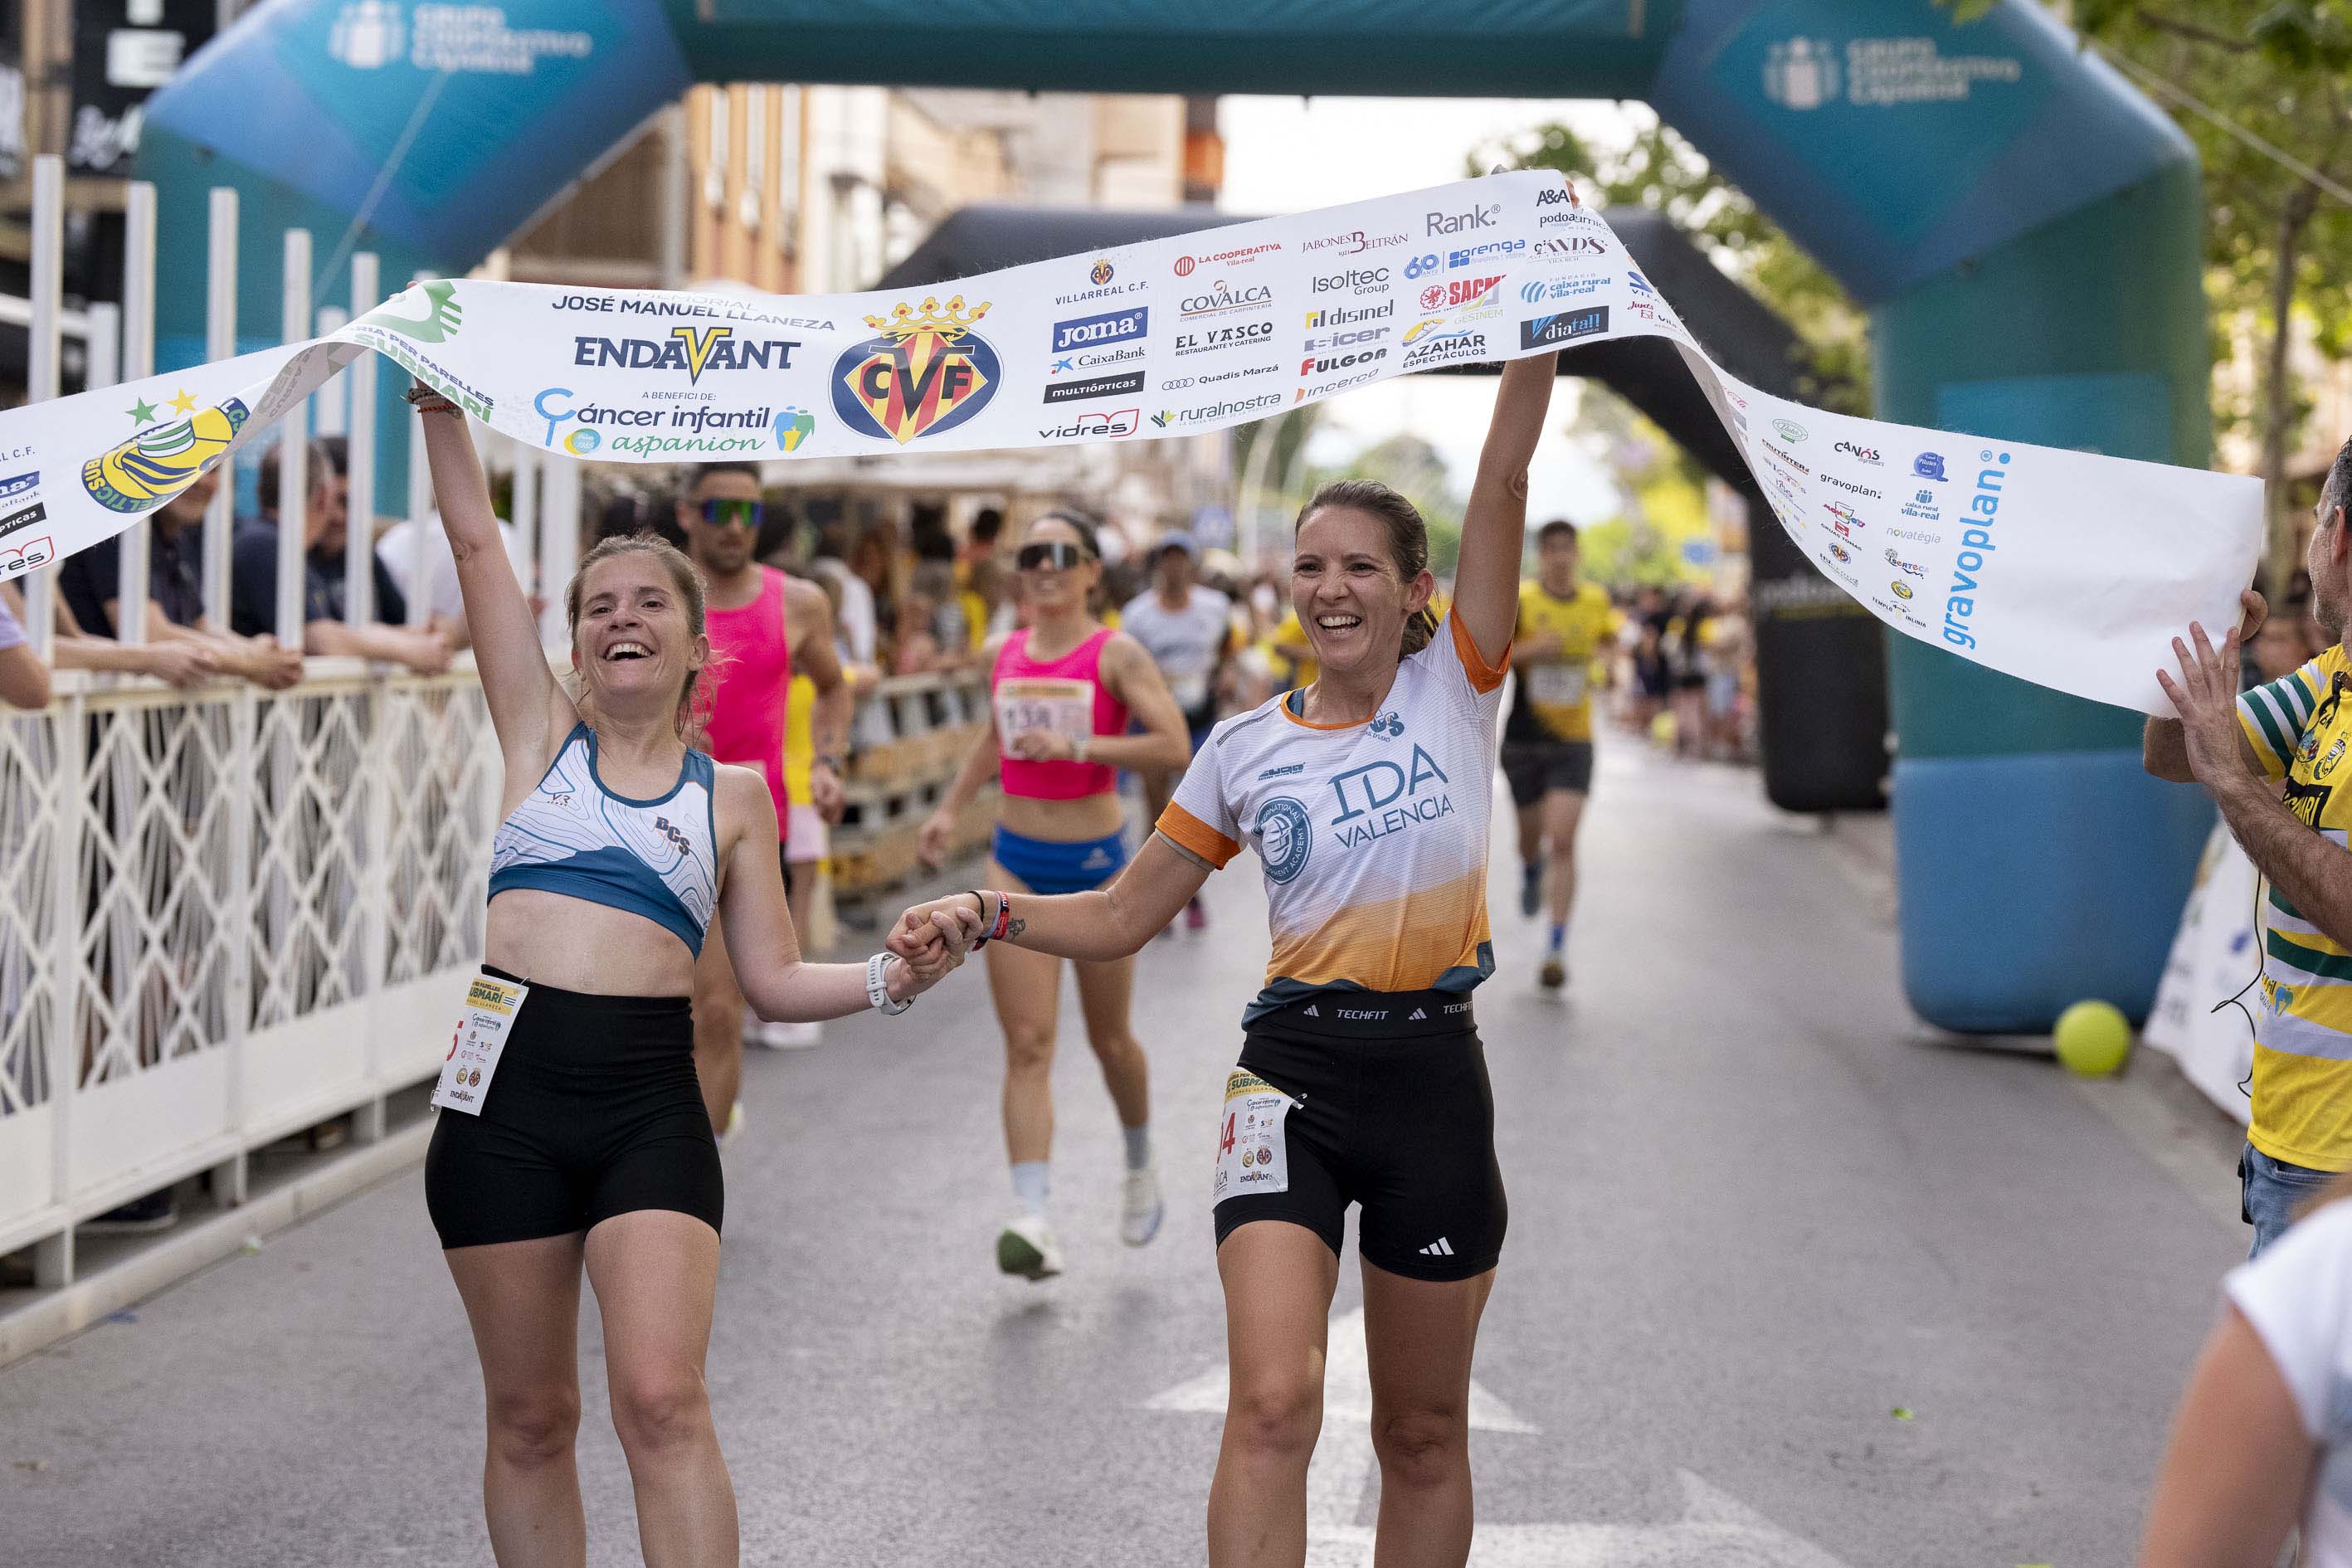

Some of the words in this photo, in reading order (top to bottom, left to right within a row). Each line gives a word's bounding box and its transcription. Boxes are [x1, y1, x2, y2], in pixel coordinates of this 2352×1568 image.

[1199, 256, 1211, 264] LA
[1214, 243, 1282, 261] COOPERATIVA
[1302, 233, 1351, 253] JABONES
[1226, 256, 1255, 266] Vila-real
[1403, 254, 1439, 280] 60
[1312, 267, 1390, 294] Isoltec
[1355, 284, 1390, 295] Group
[1582, 277, 1611, 286] rural
[1055, 286, 1124, 305] VILLARREAL
[1128, 281, 1149, 292] C.F.
[1181, 285, 1272, 313] COVALCA
[1550, 285, 1595, 299] vila-real
[552, 295, 615, 313] JOSÉ
[621, 299, 719, 318] MANUEL
[726, 309, 835, 331] LLANEZA
[1176, 334, 1199, 349] EL
[1207, 322, 1273, 344] VASCO
[574, 327, 801, 387] ENDAVANT
[1079, 347, 1146, 366] CaixaBank
[1176, 343, 1227, 357] RESTAURANTE
[1234, 336, 1272, 347] CATERING
[1405, 334, 1486, 361] AZAHAR
[1301, 348, 1387, 377] FULGOR
[1403, 347, 1487, 368] ESPECTÁCULOS
[353, 333, 494, 424] SUBMARÍ
[389, 334, 418, 358] PER
[420, 354, 494, 407] PARELLES
[1200, 371, 1240, 384] Quadis
[1243, 363, 1279, 377] Marzá
[863, 345, 975, 421] CVF
[642, 392, 649, 400] A
[651, 391, 698, 401] BENEFICI
[700, 392, 717, 402] DE:
[1180, 393, 1282, 421] ruralnostra
[671, 405, 770, 434] infantil
[1039, 422, 1128, 439] vidres
[13, 446, 36, 458] C.F.
[611, 434, 765, 459] aspanion
[1833, 441, 1881, 460] CANÓS
[1, 493, 40, 508] aBank
[1901, 509, 1940, 521] vila-real
[0, 553, 45, 574] res
[1327, 742, 1449, 826] IDA
[1335, 794, 1455, 850] VALENCIA
[1289, 827, 1305, 869] ACADEMY
[469, 986, 505, 1004] UBMARÍ
[1337, 1009, 1390, 1020] TECHFIT
